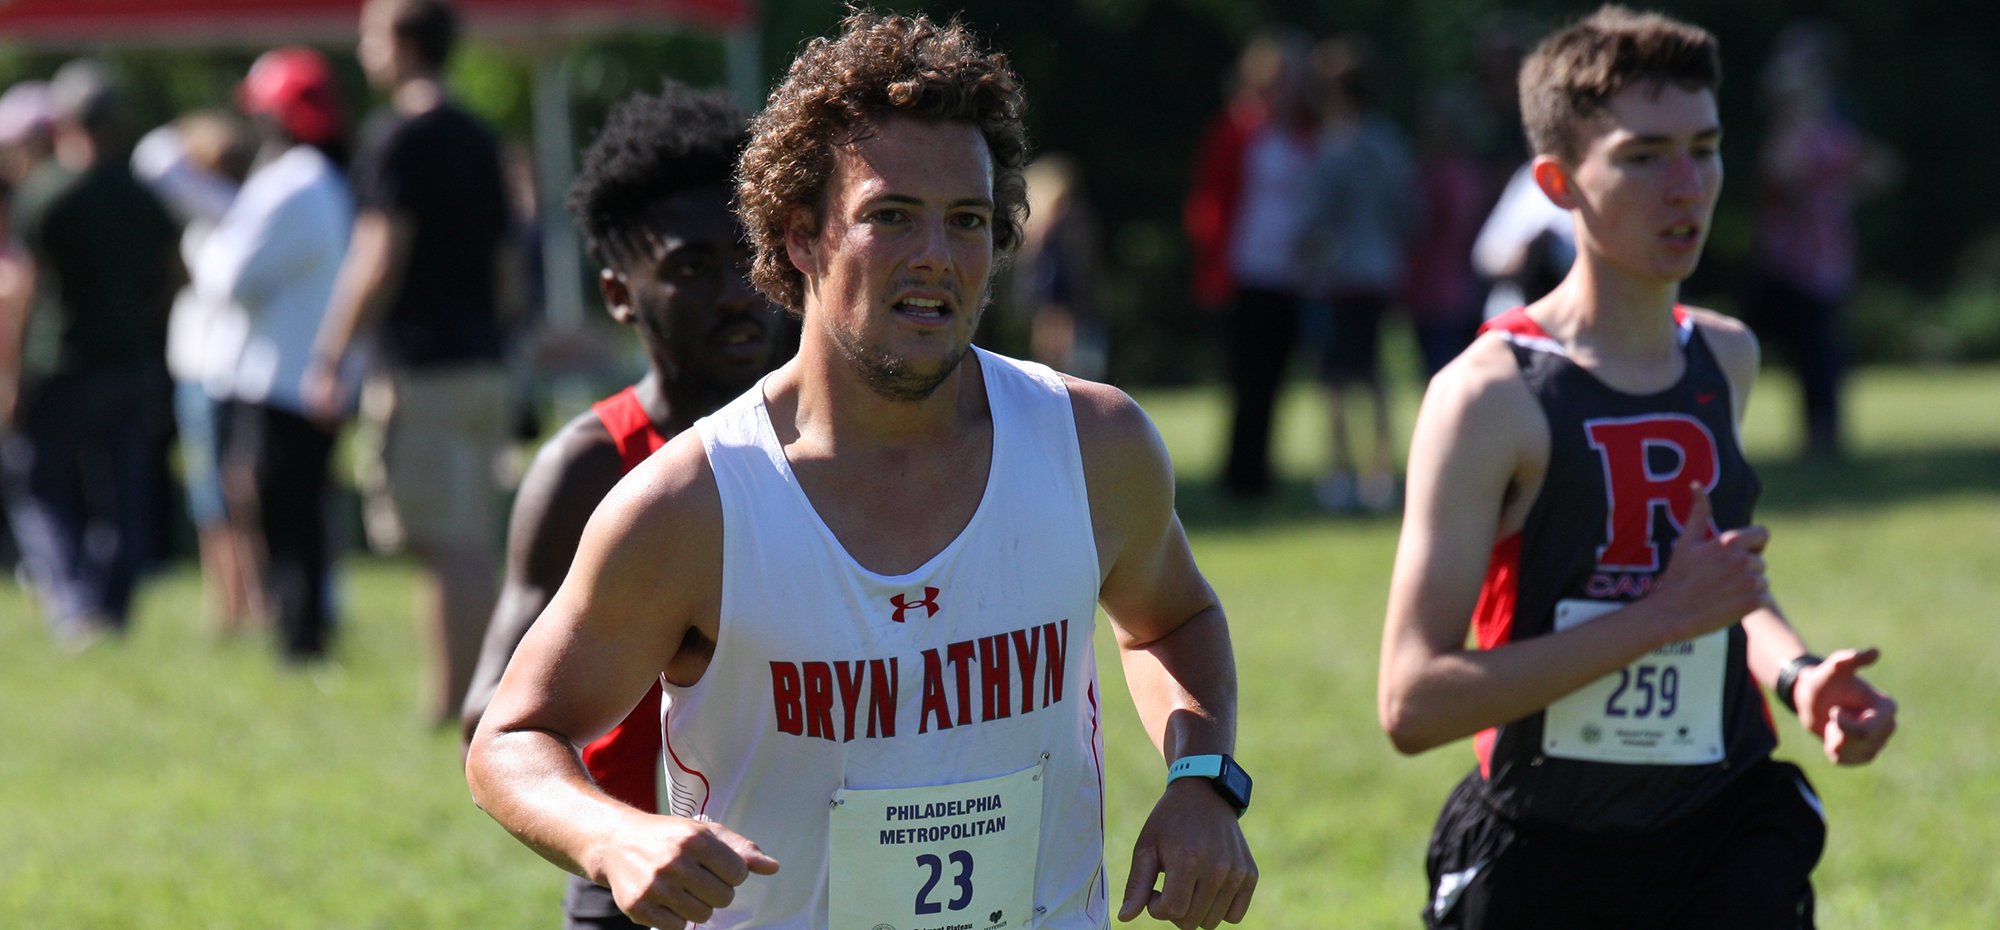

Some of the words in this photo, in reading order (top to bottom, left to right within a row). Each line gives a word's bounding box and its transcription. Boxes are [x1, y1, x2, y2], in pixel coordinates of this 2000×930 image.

[1583, 412, 1721, 572] R
[769, 657, 898, 743] BRYN
[918, 619, 1069, 735] ATHYN
[1605, 665, 1679, 718] 259
[879, 816, 1006, 845] METROPOLITAN
[886, 794, 1002, 821] PHILADELPHIA
[915, 850, 974, 915] 23
